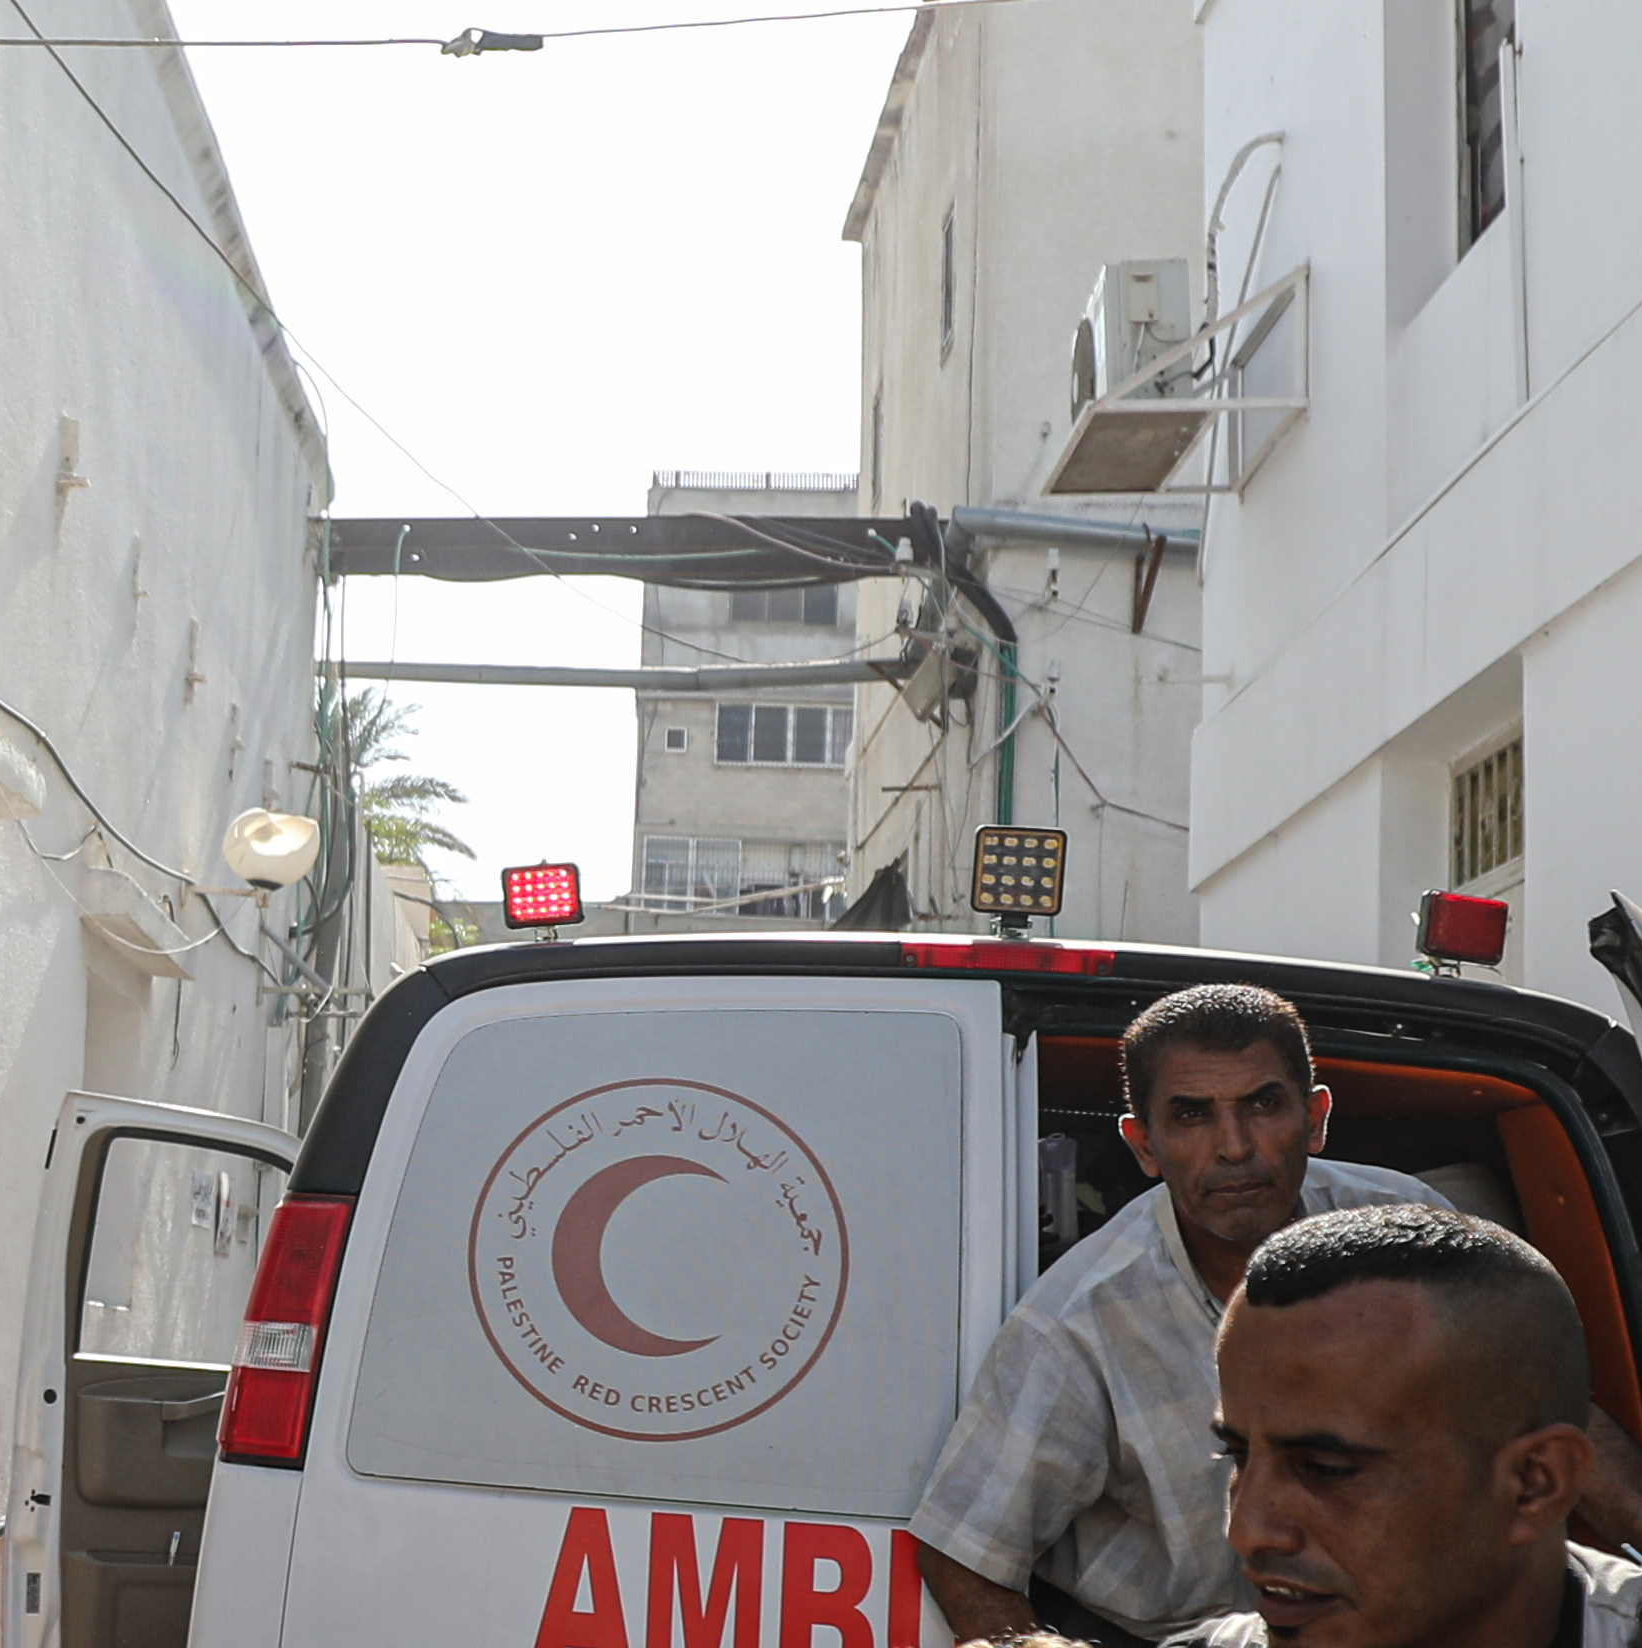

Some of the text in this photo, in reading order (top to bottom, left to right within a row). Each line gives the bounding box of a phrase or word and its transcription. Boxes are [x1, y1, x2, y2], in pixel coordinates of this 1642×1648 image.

[497, 1110, 603, 1240] الفلسطيني
[697, 1110, 790, 1174] الهلال
[774, 1175, 823, 1256] جمعية
[496, 1256, 822, 1414] PALESTINE RED CRESCENT SOCIETY
